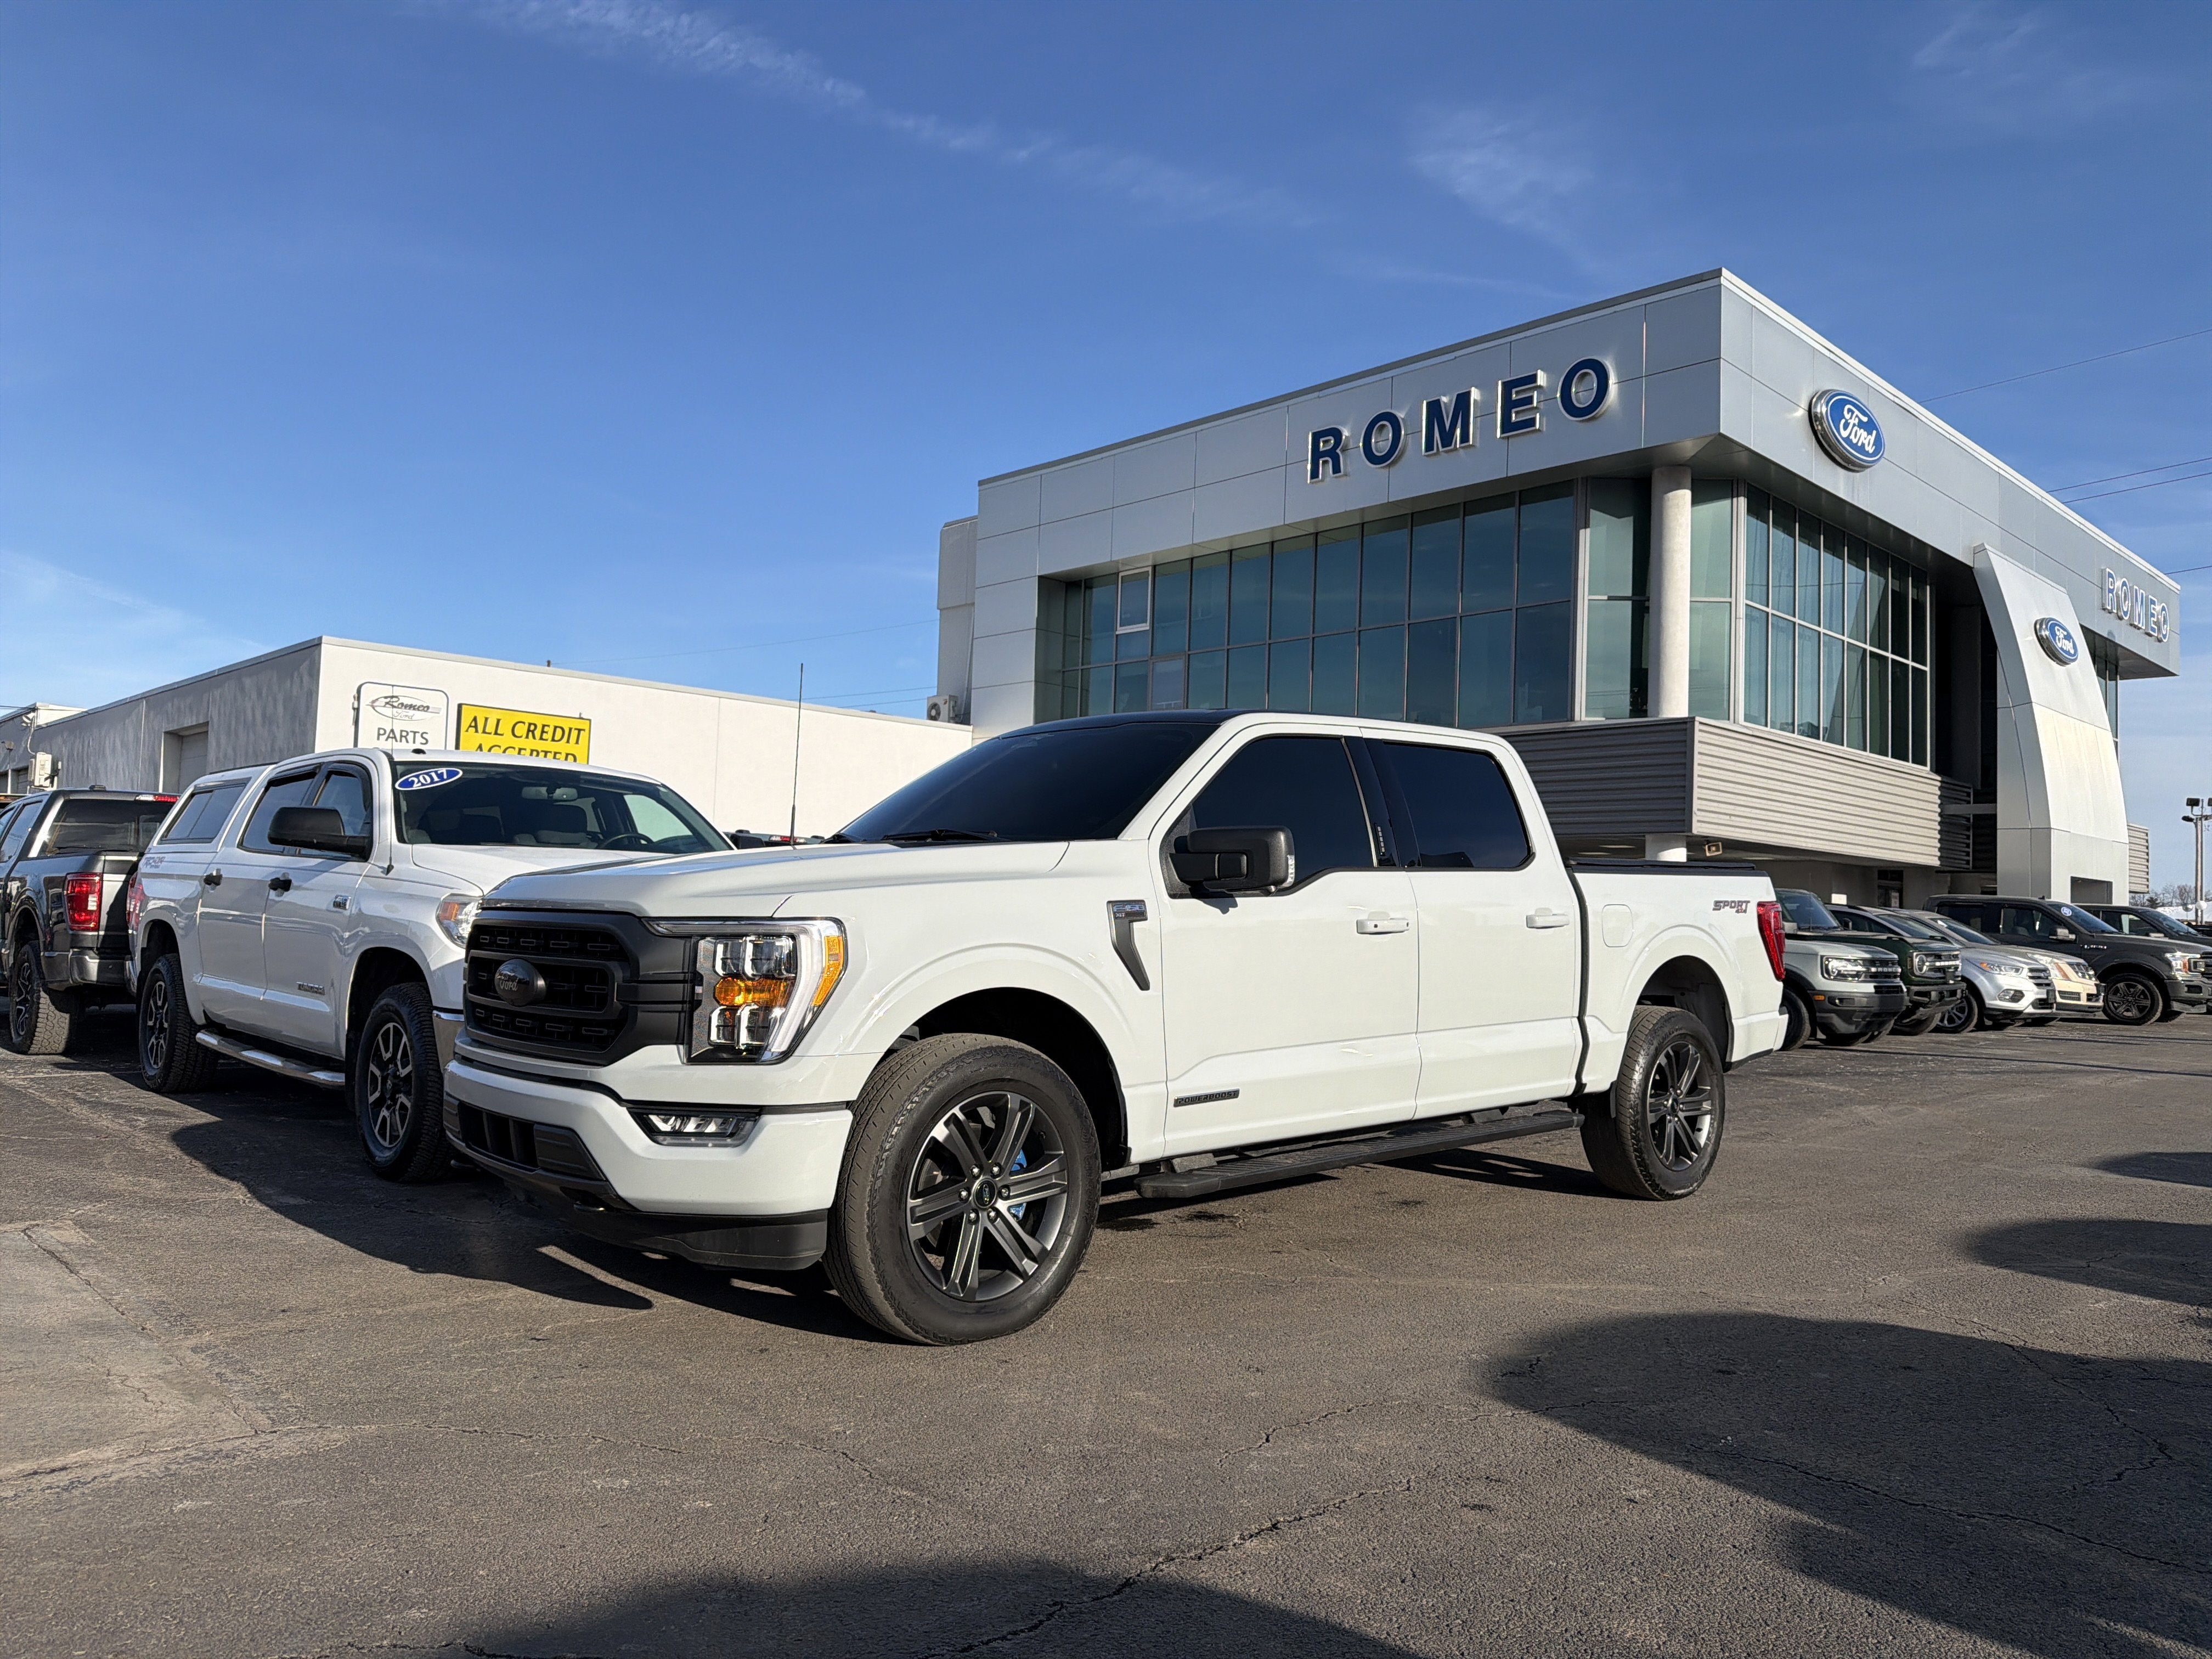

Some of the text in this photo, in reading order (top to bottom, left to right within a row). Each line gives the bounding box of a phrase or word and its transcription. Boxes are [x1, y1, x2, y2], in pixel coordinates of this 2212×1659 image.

[1308, 357, 1612, 484] ROMEO
[1839, 404, 1876, 454] Ford
[2105, 568, 2170, 642] ROMEO
[2055, 626, 2074, 654] Ford
[384, 695, 430, 712] Romeo
[393, 710, 415, 719] Ford
[376, 727, 429, 745] PARTS
[465, 715, 586, 745] ALL CREDIT
[408, 769, 447, 788] 2017
[1712, 900, 1751, 911] SPORT
[1177, 1091, 1238, 1104] POWERBOOST
